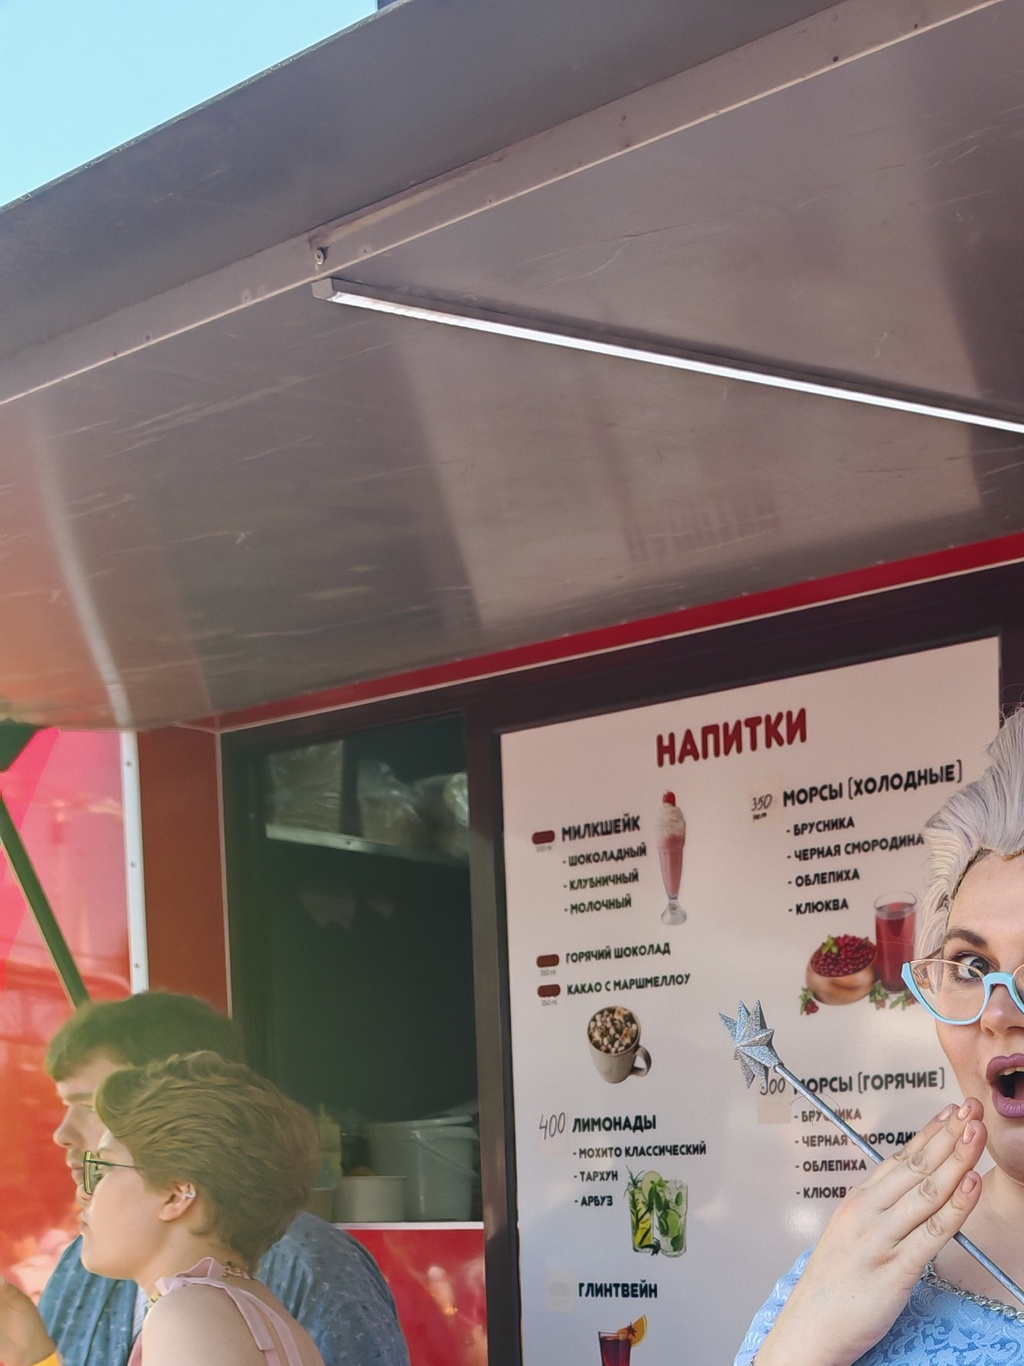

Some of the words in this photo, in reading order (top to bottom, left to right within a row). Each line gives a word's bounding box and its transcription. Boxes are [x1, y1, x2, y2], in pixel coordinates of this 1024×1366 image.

[656, 707, 807, 768] НАПИТКИ
[783, 783, 843, 807] МОРСЫ
[561, 813, 641, 842] МИЛКШЕЙК
[794, 816, 855, 836] БРУСНИКА
[568, 842, 647, 866] ШОКОЛАДНЫЙ
[794, 844, 841, 861] ЧЕРНАЯ
[844, 833, 925, 855] СМОРОДИНА
[569, 868, 639, 890] КЛУБНИЧНЫЙ
[795, 868, 860, 887] ОБЛЕПИХА
[570, 893, 632, 914] МОЛОЧНЫЙ
[795, 898, 849, 915] КЛЮКВА
[566, 946, 611, 964] ГОРЯЧИЙ
[614, 942, 671, 959] ШОКОЛАД
[567, 982, 602, 995] КАКАО
[605, 981, 611, 992] С
[613, 973, 690, 991] МАРШМЕЛЛОУ
[572, 1114, 656, 1132] ЛИМОНАДЫ
[801, 1108, 862, 1122] БРУИКА
[539, 1112, 566, 1140] 400
[579, 1147, 622, 1159] МОХИТО
[624, 1140, 706, 1157] КЛАССИЧЕСКИЙ
[802, 1134, 848, 1147] ЧЕРНАЯ
[803, 1159, 867, 1172] ОБЛЕПИХА
[580, 1170, 618, 1182] ТАРХУН
[581, 1196, 613, 1207] АРБУЗ
[803, 1186, 853, 1199] КЛЮКВ
[578, 1279, 658, 1299] ГЛИНТВЕЙН
